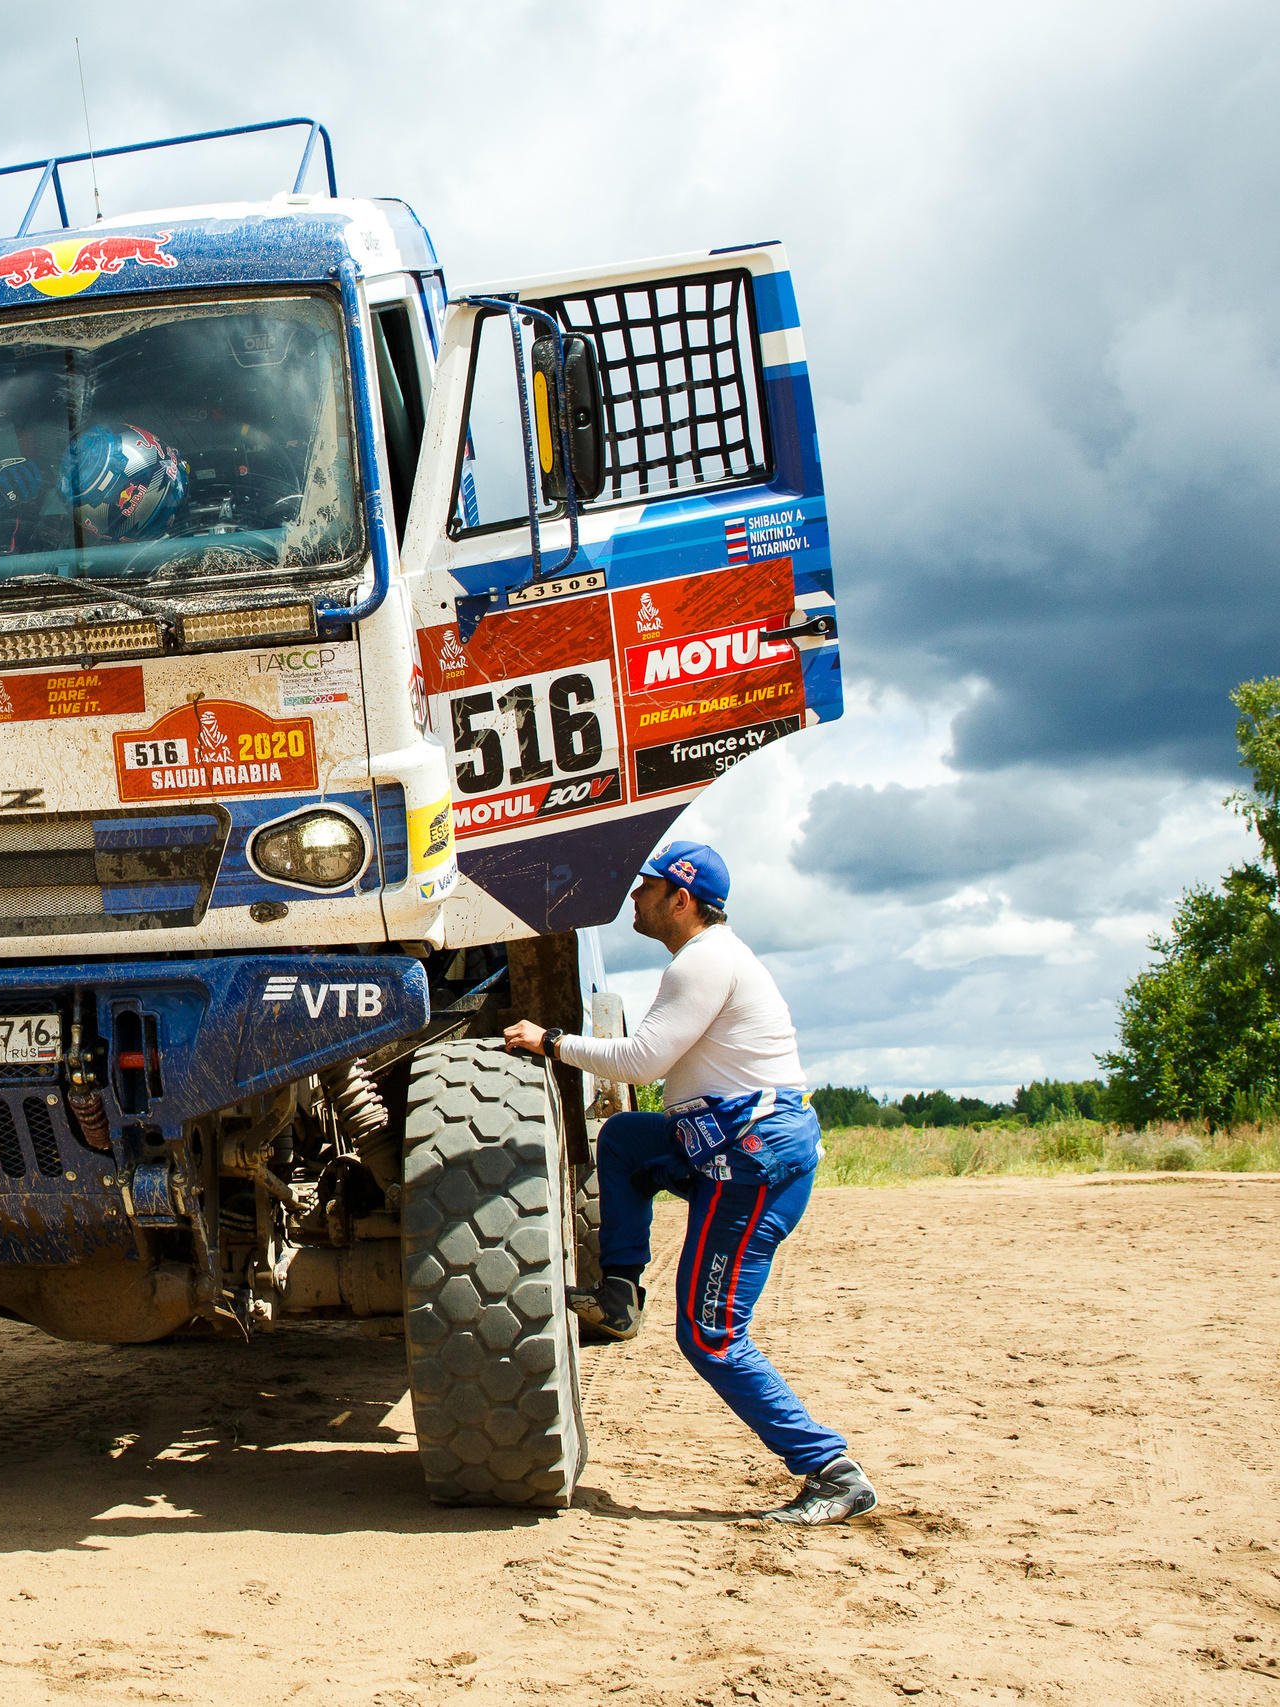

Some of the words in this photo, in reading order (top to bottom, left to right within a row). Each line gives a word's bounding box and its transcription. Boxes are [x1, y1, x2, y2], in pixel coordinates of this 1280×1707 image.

[121, 497, 138, 518] Red
[132, 484, 148, 504] Bull
[748, 510, 794, 530] SHIBALOV
[796, 508, 806, 521] A.
[750, 526, 784, 544] NIKITIN
[786, 525, 796, 537] D.
[751, 537, 801, 558] TATARINOV
[803, 536, 810, 548] I.
[636, 617, 664, 633] DAKAR
[642, 631, 660, 641] 2020
[439, 655, 468, 671] DAKAR
[643, 627, 777, 685] MOTUL
[47, 675, 102, 690] DREAM.
[445, 669, 466, 679] 2020
[48, 689, 90, 703] DARE.
[640, 704, 696, 727] DREAM.
[699, 695, 742, 714] DARE.
[745, 685, 776, 705] LIVE
[778, 682, 794, 697] IT.
[49, 702, 81, 715] LIVE
[84, 700, 102, 713] IT.
[450, 673, 603, 794] 516
[135, 741, 178, 767] 516
[193, 746, 234, 765] DAKAR
[238, 729, 304, 761] 2020
[715, 746, 762, 772] spo
[151, 766, 207, 790] SAUDI
[212, 762, 282, 784] ARABIA
[453, 794, 535, 829] MOTUL
[544, 774, 615, 809] 300V
[668, 863, 681, 877] Red
[679, 870, 695, 885] Bull
[300, 982, 383, 1019] VTB
[11, 1047, 38, 1058] RUS
[698, 1120, 716, 1147] Rostec
[701, 1253, 729, 1330] KAMAZ
